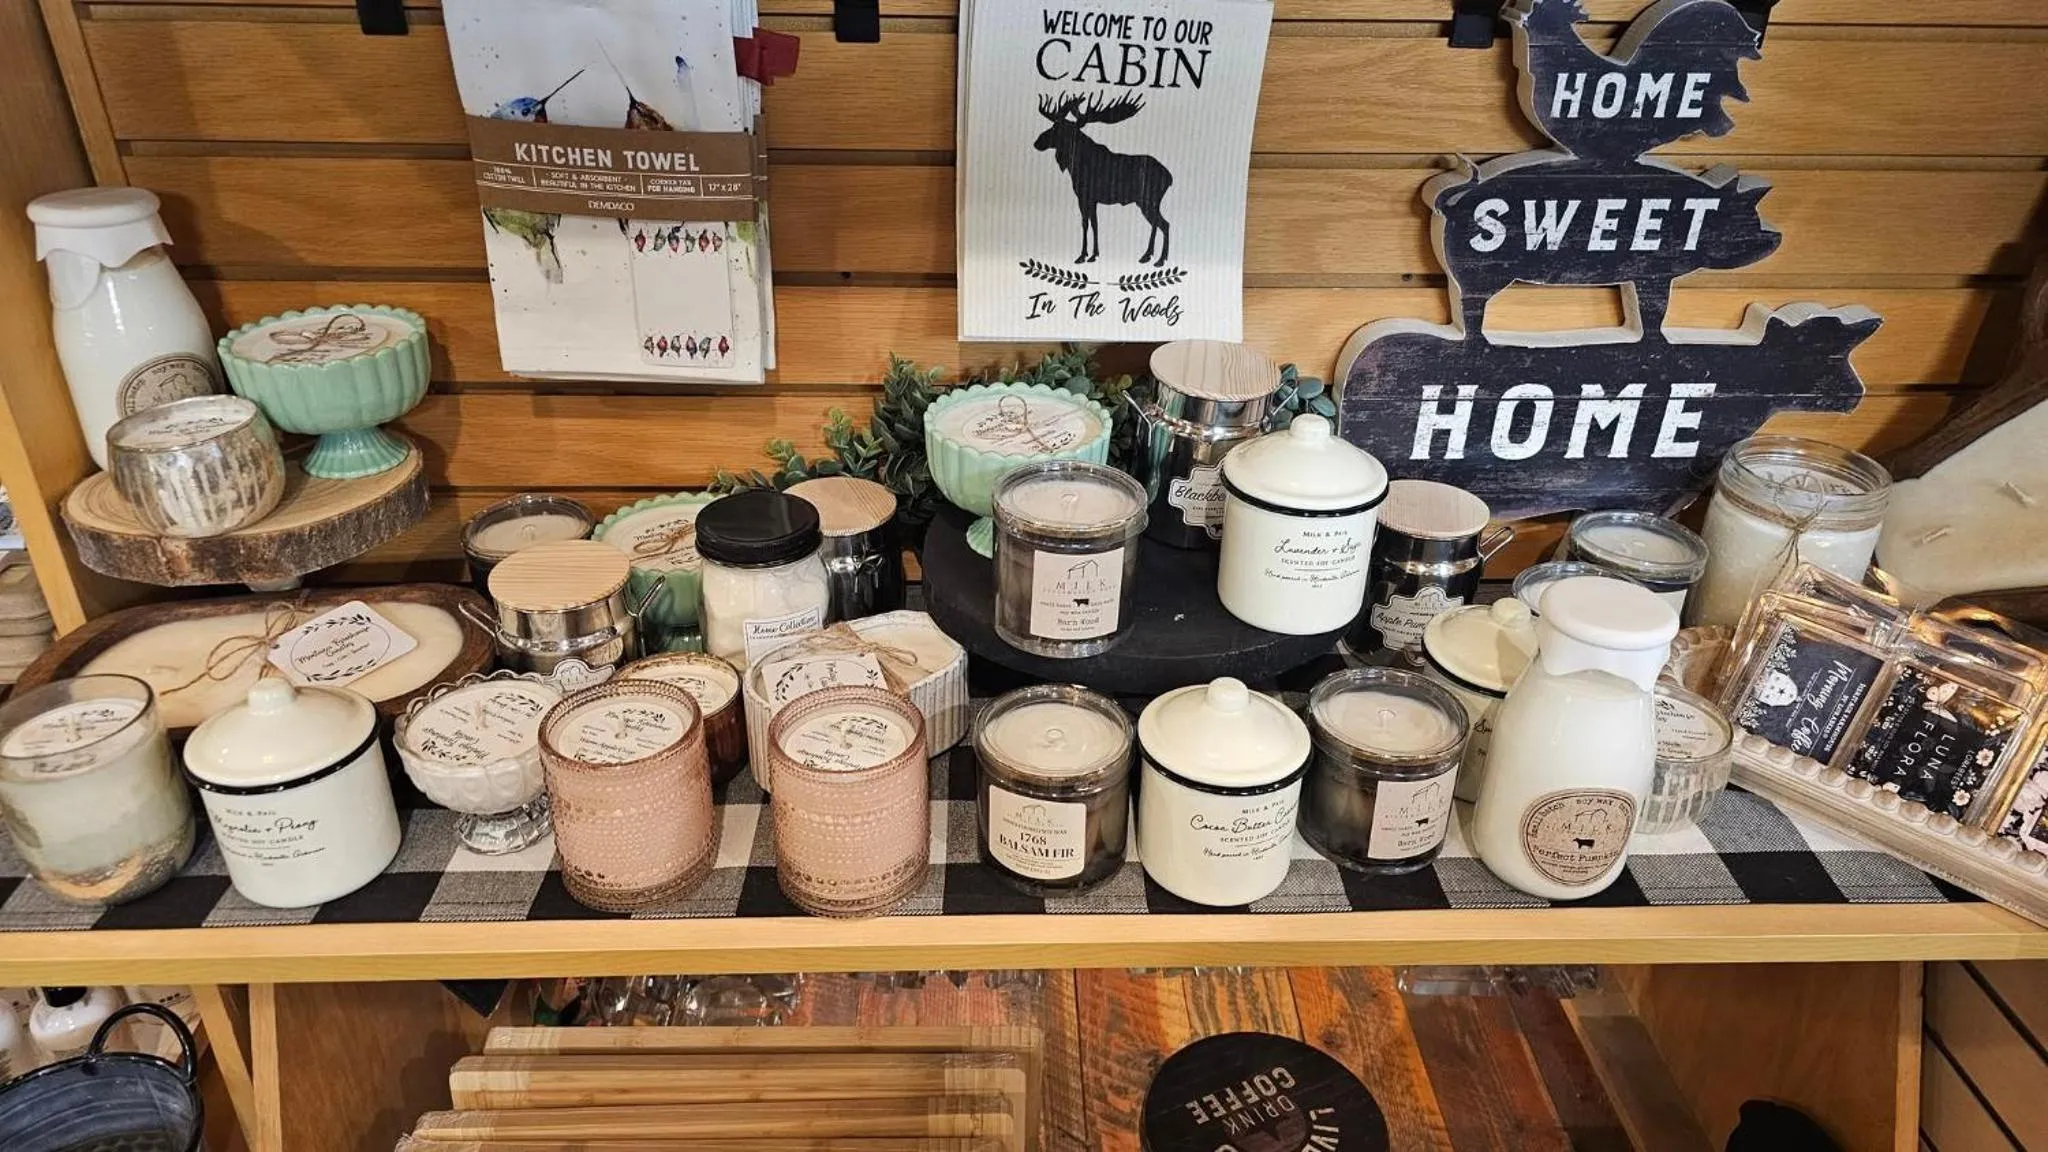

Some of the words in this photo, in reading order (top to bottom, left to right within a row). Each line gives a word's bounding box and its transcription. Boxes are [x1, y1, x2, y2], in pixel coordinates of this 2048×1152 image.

[1043, 9, 1135, 39] WELCOME
[1143, 16, 1167, 40] TO
[1174, 20, 1213, 45] OUR
[1035, 38, 1212, 90] CABIN
[1550, 72, 1712, 119] HOME
[514, 142, 613, 168] KITCHEN
[622, 150, 700, 171] TOWEL
[540, 179, 577, 188] BEAUTIFUL
[606, 184, 636, 192] KITCHEN
[551, 172, 569, 180] SOFT
[580, 174, 622, 183] ABSORBENT
[663, 186, 696, 194] HANGING
[588, 201, 635, 211] DEMDACO
[1469, 198, 1720, 252] SWEET
[1026, 291, 1056, 320] In
[1069, 291, 1106, 319] The
[1118, 295, 1184, 326] Woods
[1409, 382, 1718, 461] HOME
[1274, 538, 1329, 555] Lavender
[1807, 659, 1854, 711] Morning
[1893, 720, 1935, 776] FLORA
[1919, 733, 1957, 780] LUNA
[274, 817, 319, 834] Peony
[1020, 832, 1047, 846] 1768
[1190, 814, 1229, 832] Cocoa
[1231, 817, 1271, 834] Butter
[999, 833, 1050, 858] BALSAM
[1053, 848, 1075, 858] FIR
[1532, 845, 1577, 862] Perfect
[1185, 1066, 1296, 1125] COFFEE
[1222, 1095, 1295, 1136] DRINK
